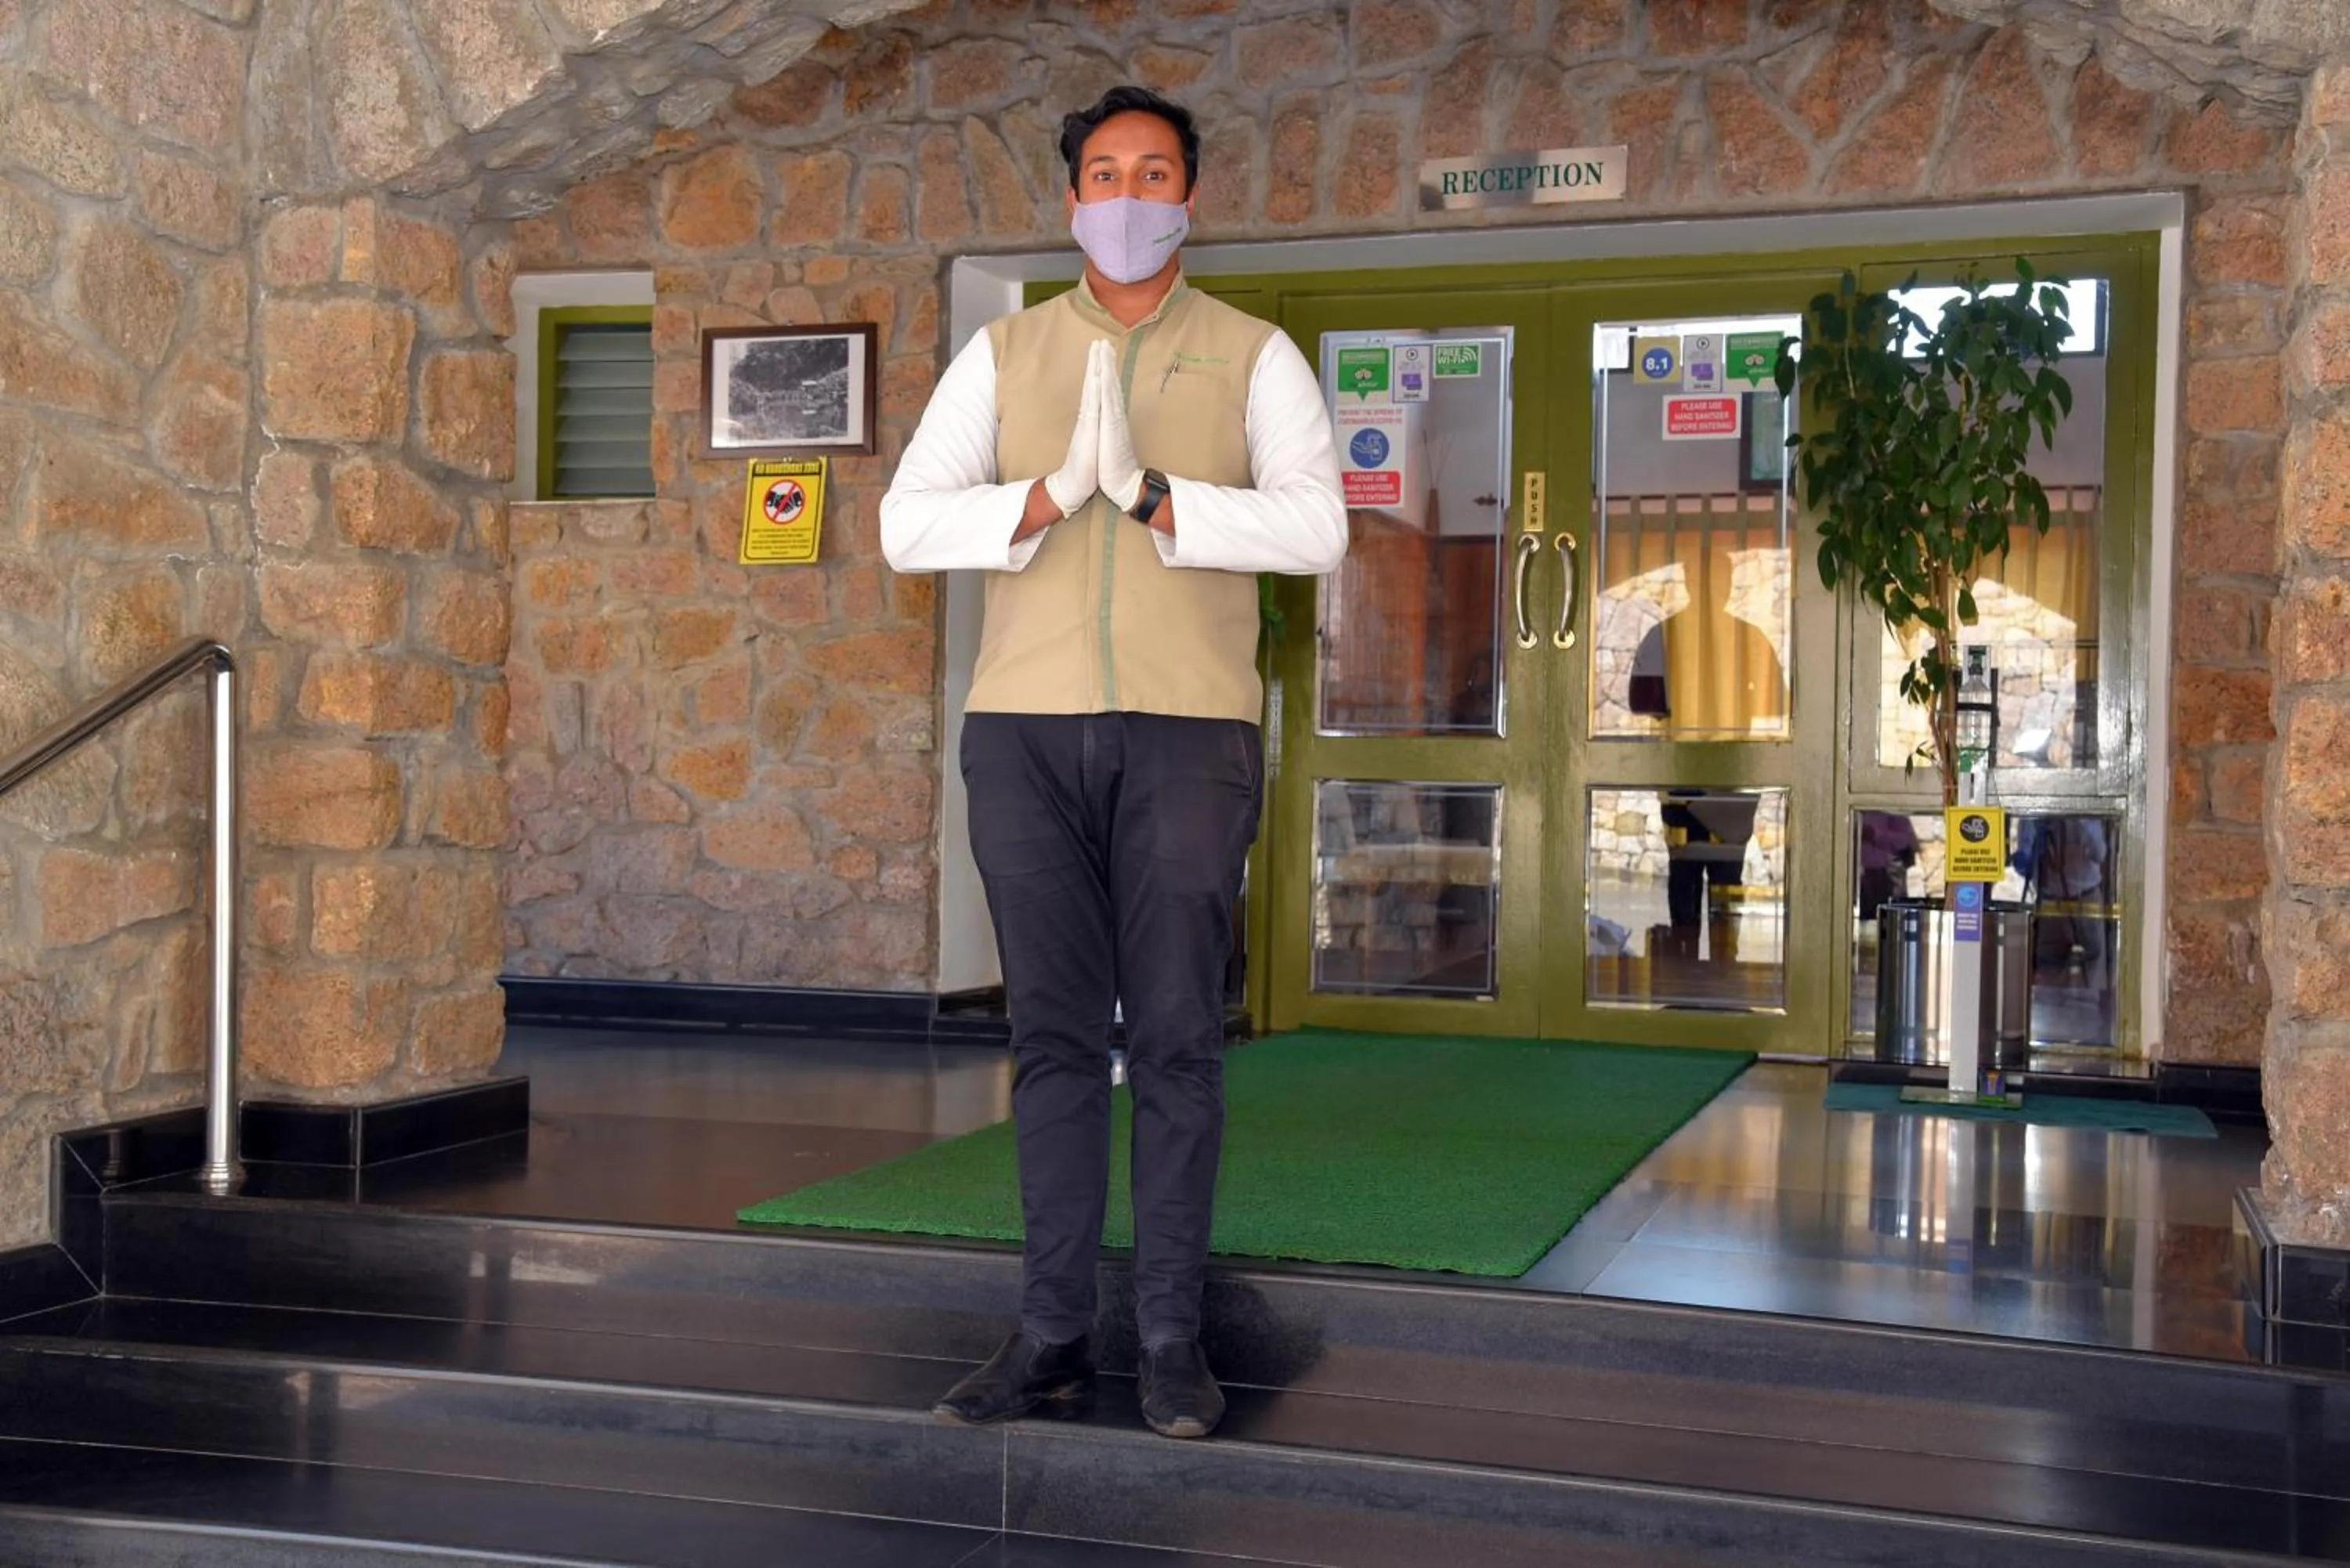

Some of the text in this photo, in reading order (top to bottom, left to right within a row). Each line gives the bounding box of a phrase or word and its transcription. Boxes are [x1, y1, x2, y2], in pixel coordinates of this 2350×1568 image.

[1441, 161, 1604, 195] RECEPTION
[1645, 356, 1668, 370] 8.1
[1680, 401, 1723, 410] PLEASE USE
